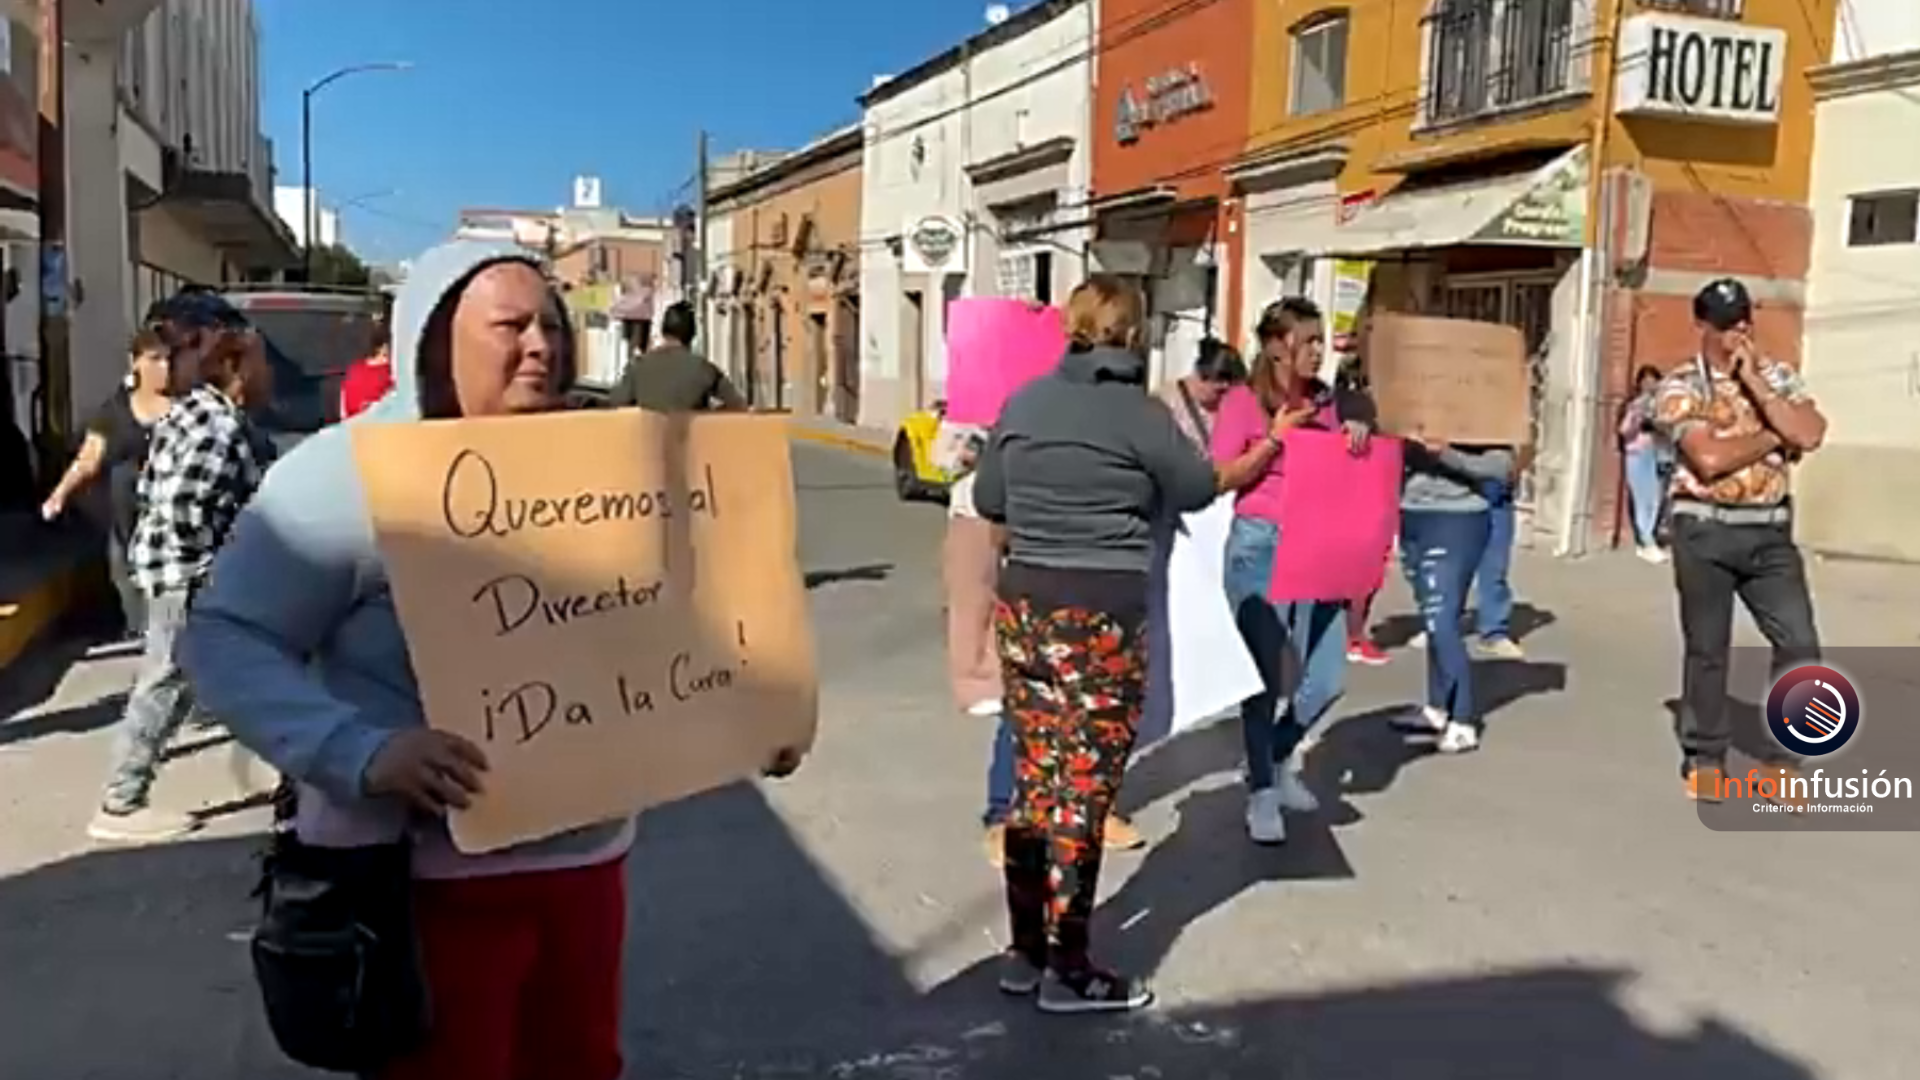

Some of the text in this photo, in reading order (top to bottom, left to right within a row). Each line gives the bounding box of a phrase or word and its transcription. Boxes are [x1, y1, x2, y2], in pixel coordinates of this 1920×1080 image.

[1648, 27, 1775, 112] HOTEL
[443, 448, 718, 538] Queremos al
[472, 574, 663, 637] Director
[481, 680, 593, 744] ¡Da
[616, 674, 654, 716] la
